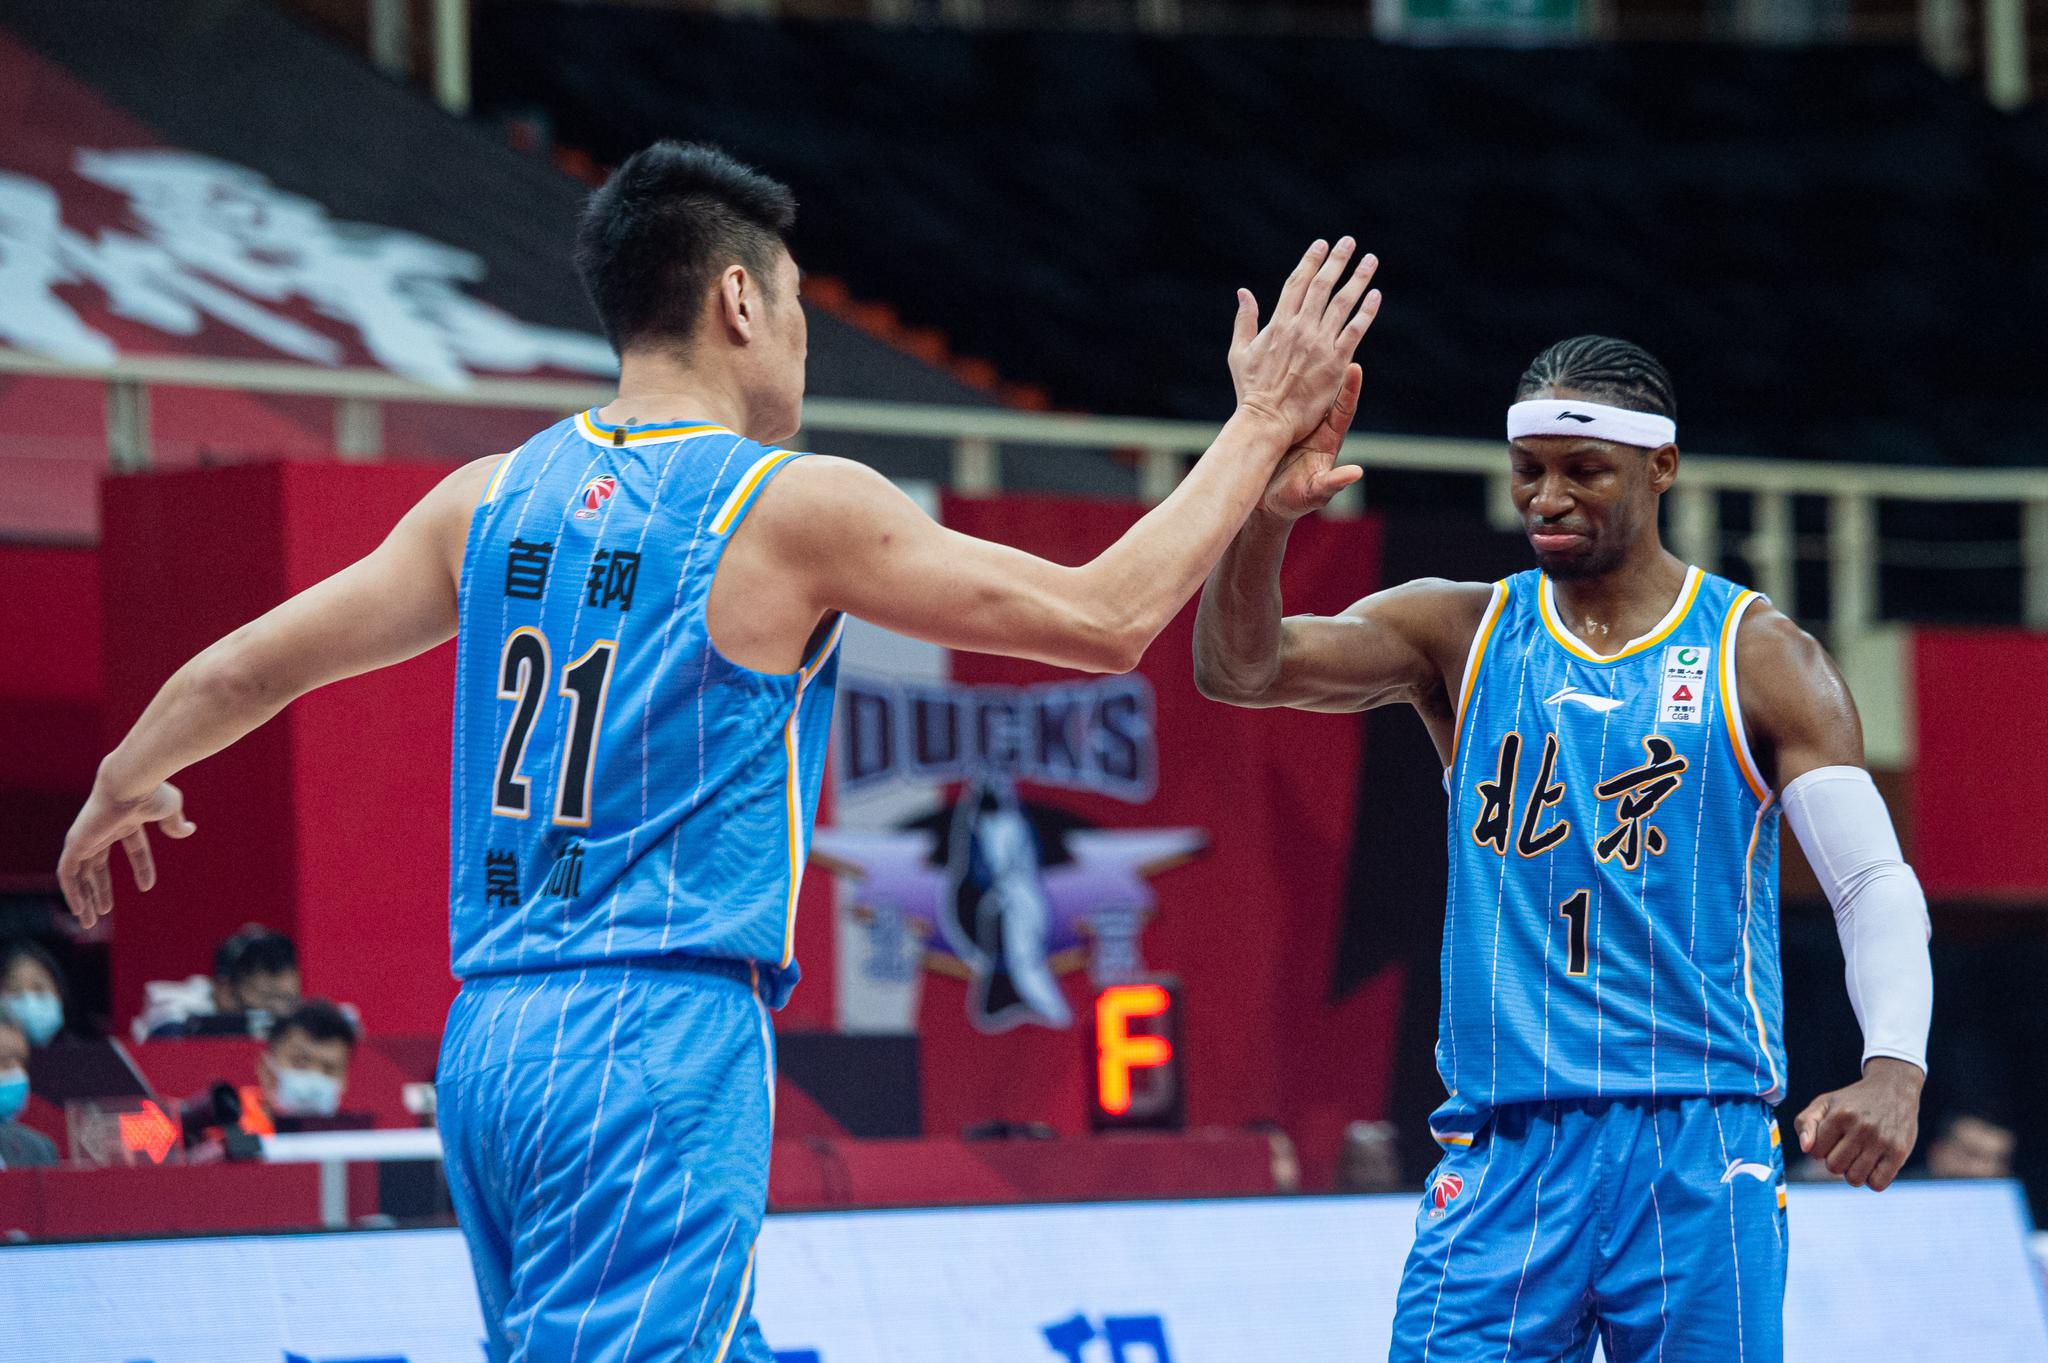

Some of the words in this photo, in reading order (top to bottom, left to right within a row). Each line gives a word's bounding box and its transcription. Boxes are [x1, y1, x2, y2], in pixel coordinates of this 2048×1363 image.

[507, 539, 641, 611] 首钢
[492, 626, 618, 827] 21
[844, 688, 1140, 790] DUCKS
[1472, 731, 1688, 870] 北京
[1560, 889, 1590, 976] 1
[1096, 984, 1172, 1115] F
